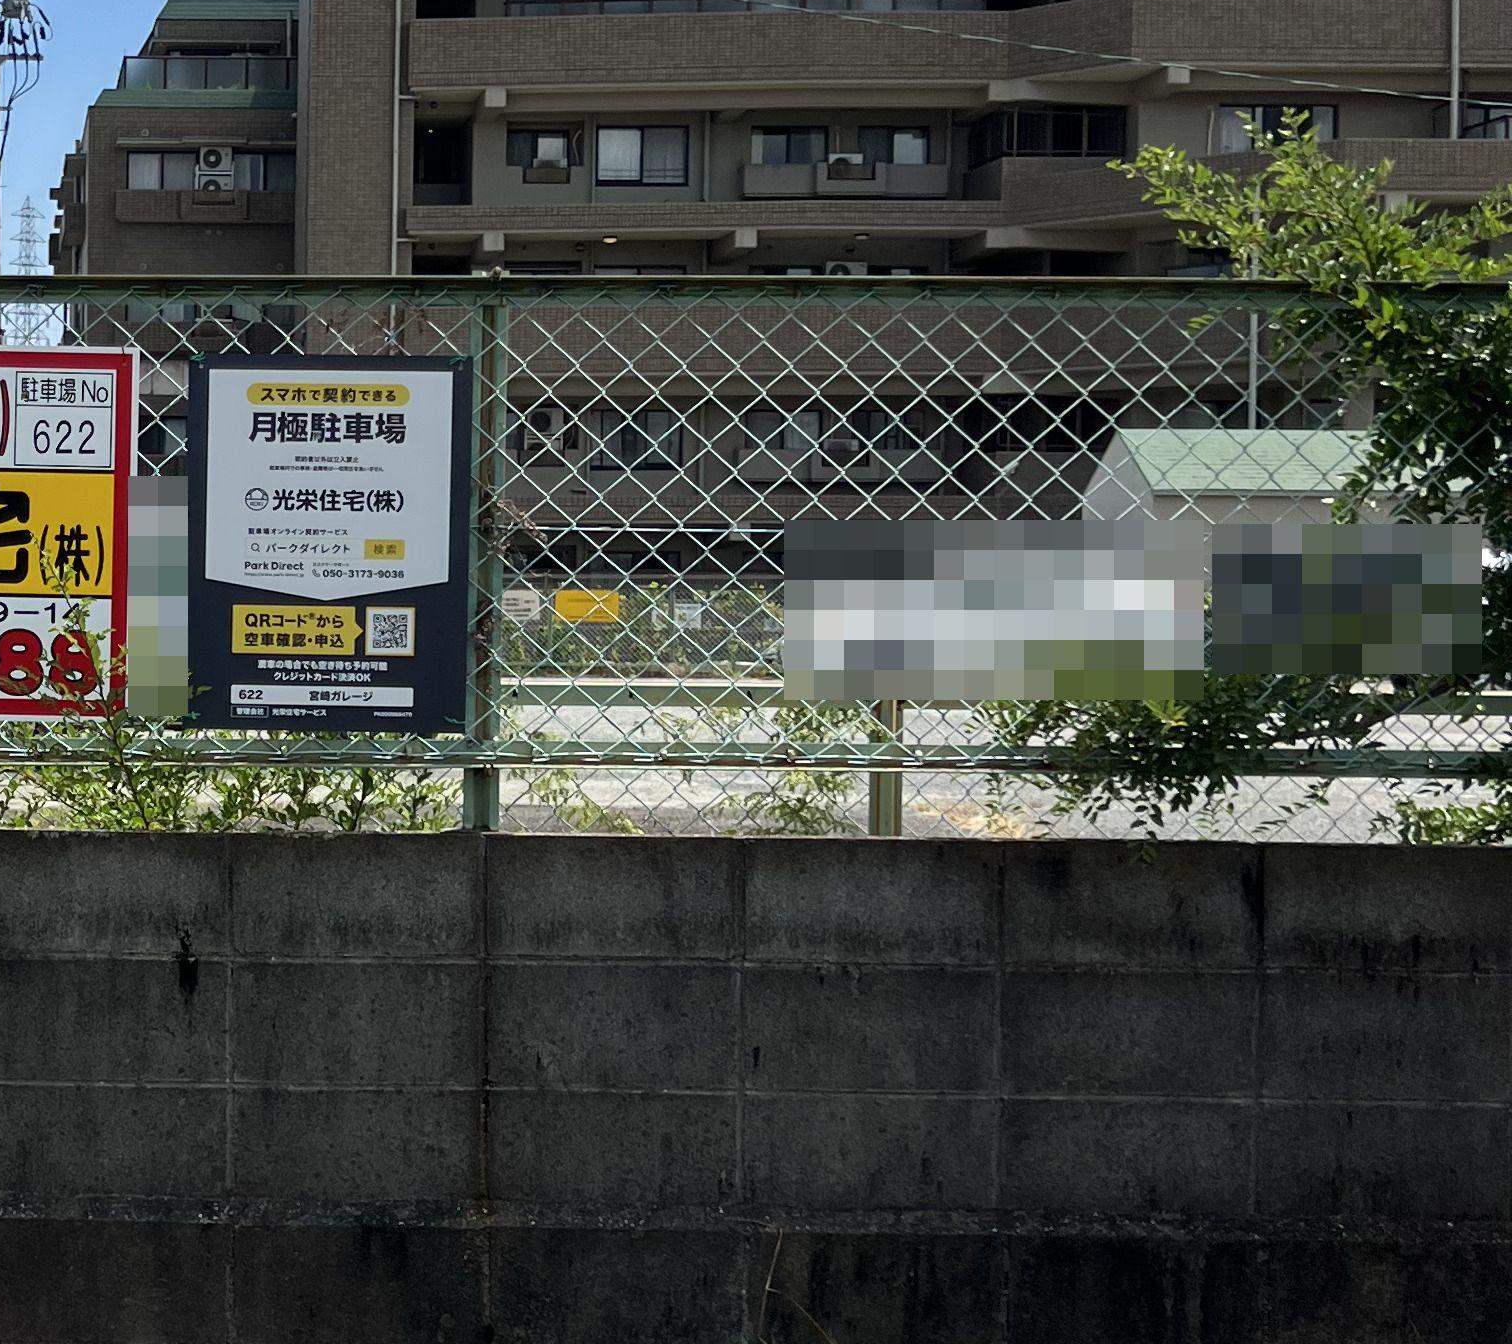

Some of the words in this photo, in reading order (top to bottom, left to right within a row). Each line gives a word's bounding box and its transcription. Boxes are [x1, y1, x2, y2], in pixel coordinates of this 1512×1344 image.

[260, 387, 396, 403] スマホで契約できる
[249, 412, 407, 444] 月極駐車場
[33, 419, 96, 454] 622
[272, 488, 405, 513] 光栄住宅(株)
[266, 542, 351, 554] パークダイレクト
[244, 561, 269, 570] Park
[271, 562, 304, 571] Direct
[244, 633, 345, 647] 空車確認・申込
[238, 689, 264, 700] 622
